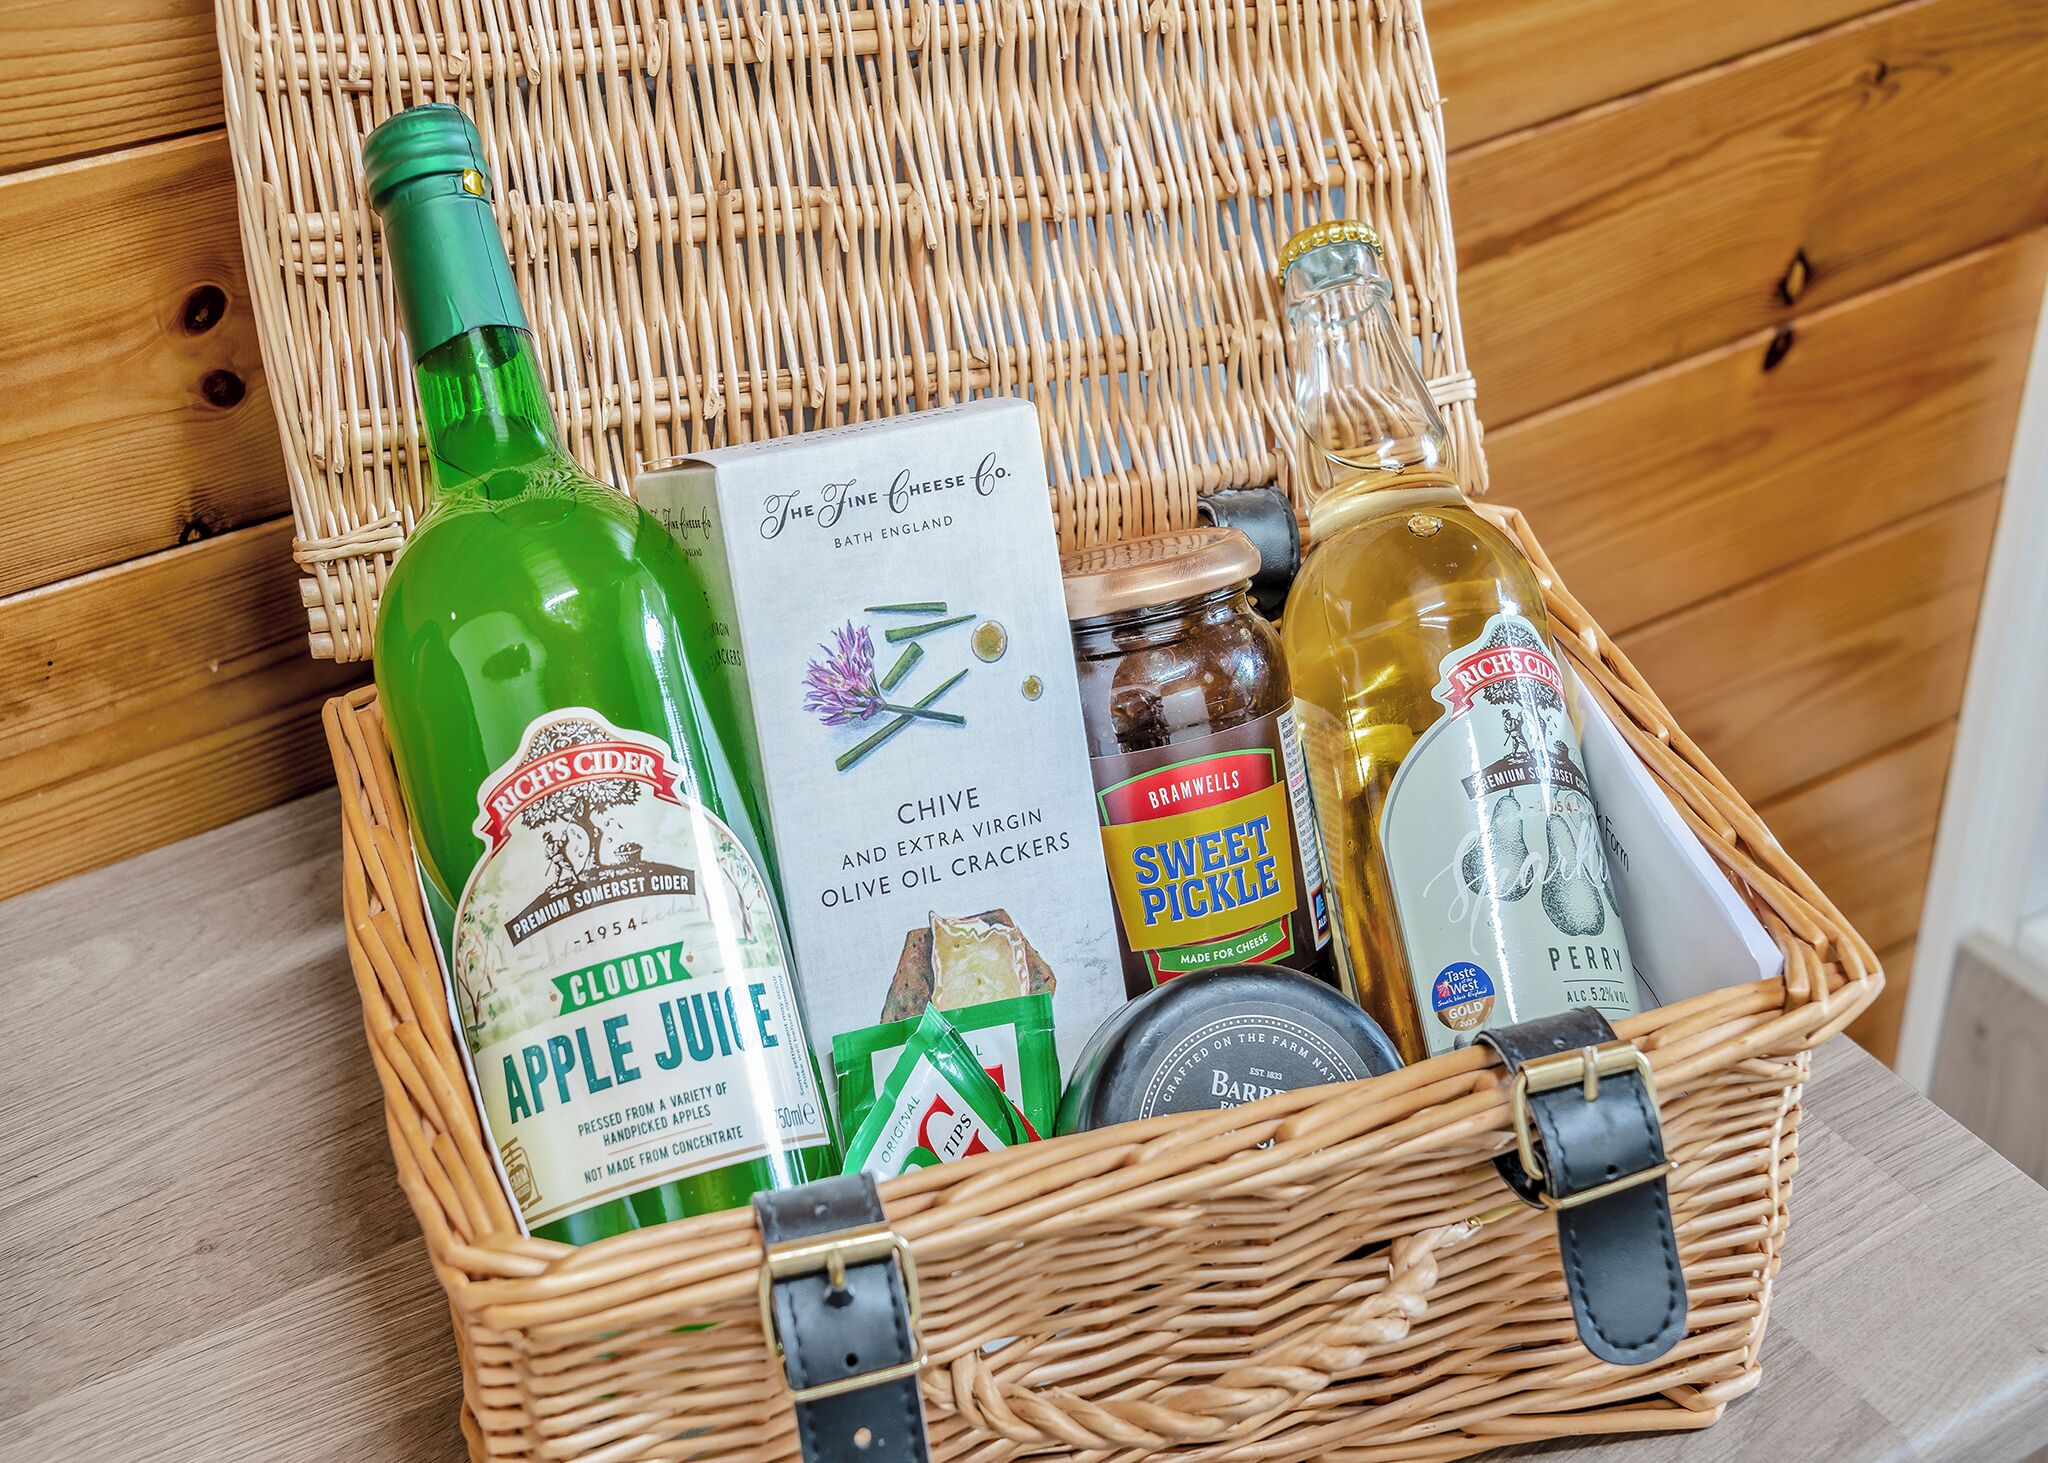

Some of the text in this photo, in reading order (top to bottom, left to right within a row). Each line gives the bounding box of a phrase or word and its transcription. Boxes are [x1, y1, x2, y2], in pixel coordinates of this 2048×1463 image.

[834, 515, 953, 549] BATH ENGLAND
[1455, 650, 1523, 691] RICH'S
[491, 750, 656, 821] RICH'S CIDER
[1148, 770, 1240, 809] BRAMWELLS
[1471, 767, 1526, 793] PREMIUM
[897, 786, 981, 825] CHIVE
[841, 808, 1042, 871] AND EXTRA VIRGIN
[1132, 815, 1270, 885] SWEET
[1605, 815, 1629, 872] Form
[821, 831, 1071, 908] OLIVE OIL CRACKERS
[1138, 855, 1282, 927] PICKLE
[512, 875, 690, 939] PREMIUM SOMERSET CIDER
[1180, 932, 1268, 965] MADE FOR CHEESE
[1548, 946, 1622, 972] PERRY
[569, 948, 675, 1006] CLOUDY
[1445, 967, 1476, 982] Taste
[1449, 979, 1479, 995] West
[1449, 1001, 1483, 1019] GOLD
[502, 1014, 642, 1125] APPLE
[1163, 1033, 1339, 1102] CRAFTED ON THE FARM NAT
[1249, 1067, 1282, 1080] EST. 1833
[577, 1081, 728, 1136] PRESSED FROM A VARIETY OF
[603, 1104, 711, 1147] HANDPICKED APPLES
[881, 1095, 921, 1163] ORIGINAL
[584, 1125, 744, 1184] NOT MADE FROM CONCENTRATE
[943, 1113, 972, 1157] TIPS
